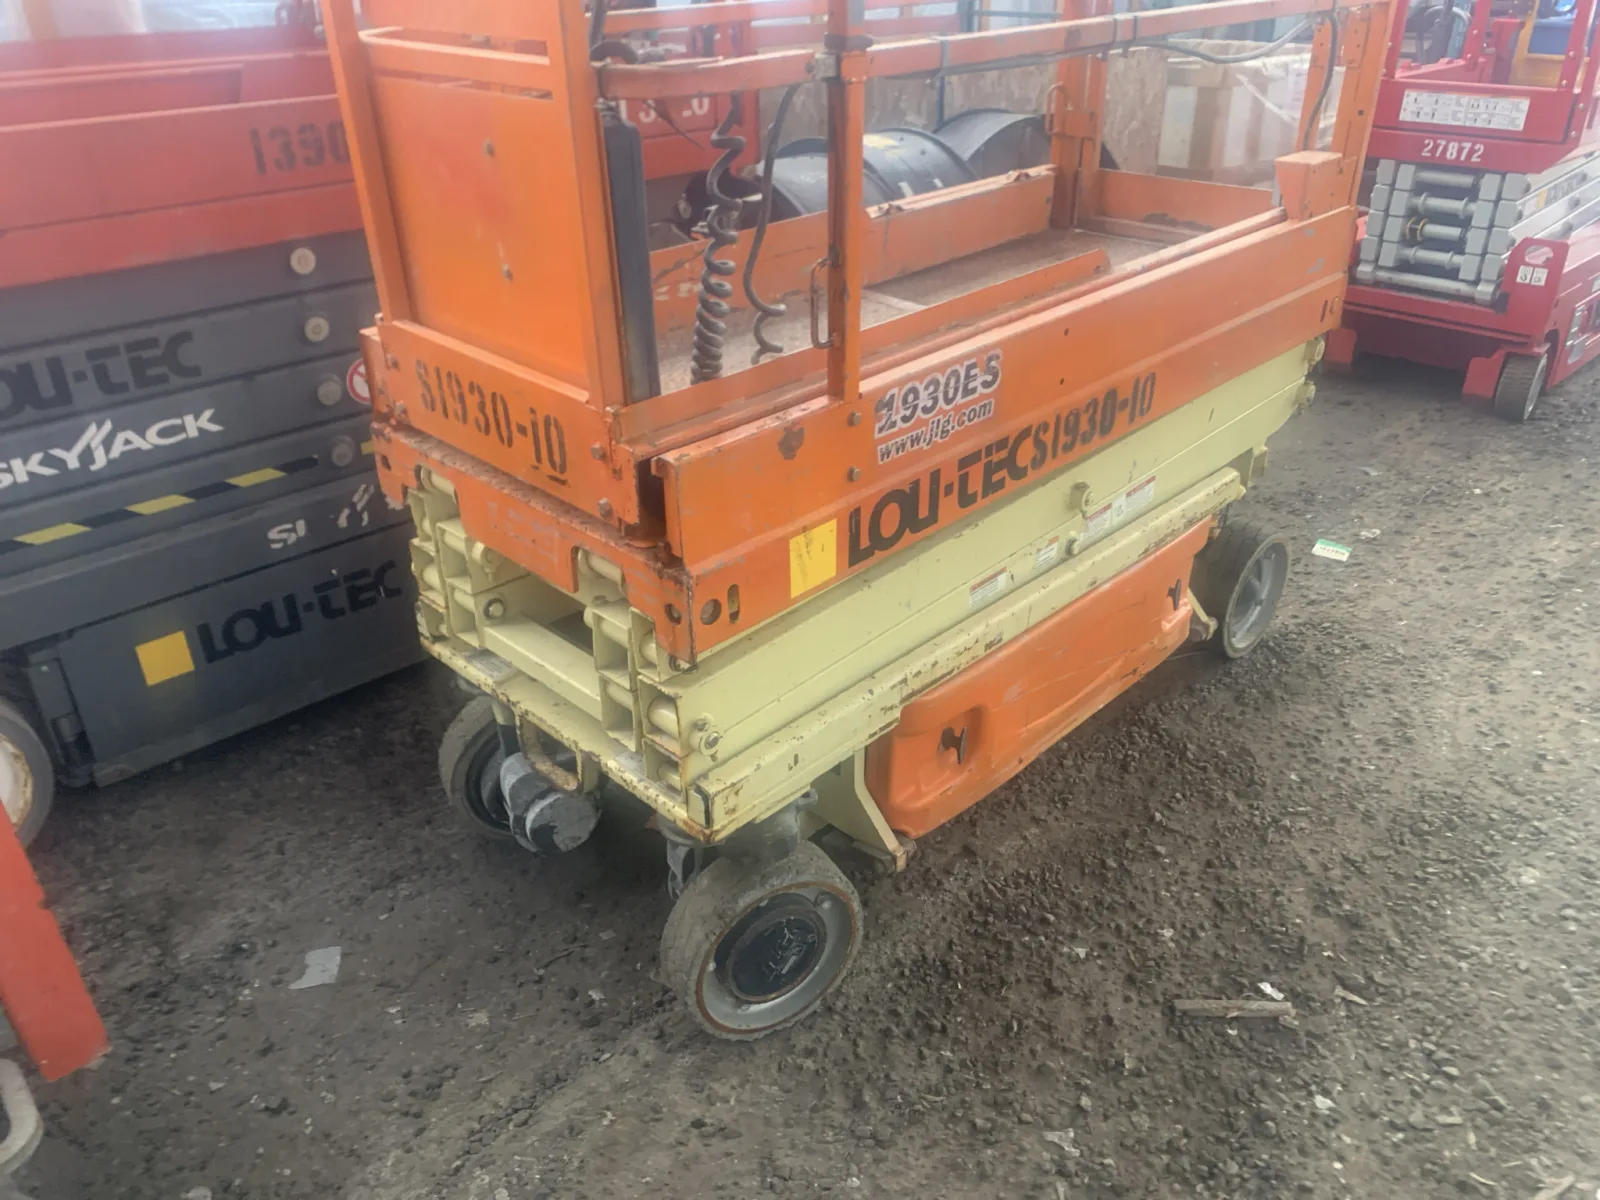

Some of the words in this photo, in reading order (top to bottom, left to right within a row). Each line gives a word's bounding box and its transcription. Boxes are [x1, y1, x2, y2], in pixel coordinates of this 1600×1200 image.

[1421, 138, 1485, 163] 27872
[415, 359, 568, 475] S1930-10
[874, 351, 1002, 437] 1930ES
[878, 400, 994, 464] www.jlg.com
[847, 424, 1033, 569] LOU-TEC
[1031, 372, 1156, 470] S1930-10
[196, 560, 403, 664] LOU-TEC
